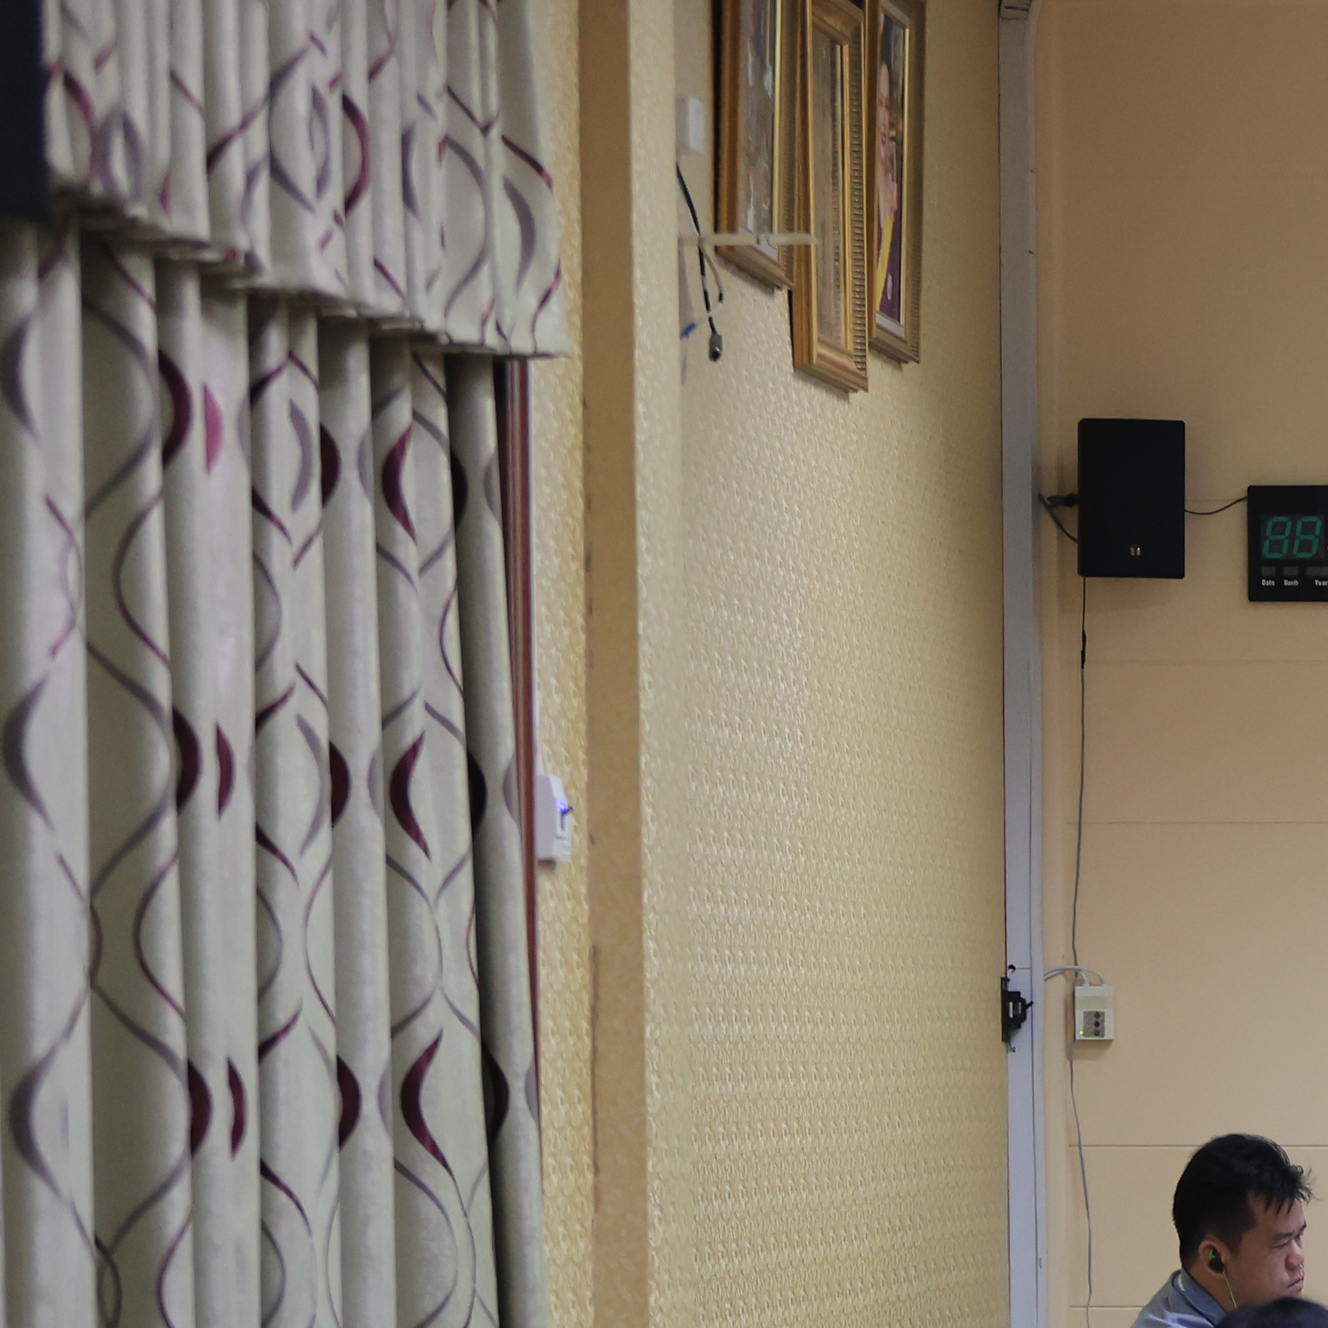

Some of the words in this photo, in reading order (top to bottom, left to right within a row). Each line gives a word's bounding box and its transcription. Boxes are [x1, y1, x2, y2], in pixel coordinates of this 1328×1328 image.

[1261, 579, 1276, 587] Date
[1283, 579, 1299, 587] Month
[1314, 579, 1328, 587] Year
